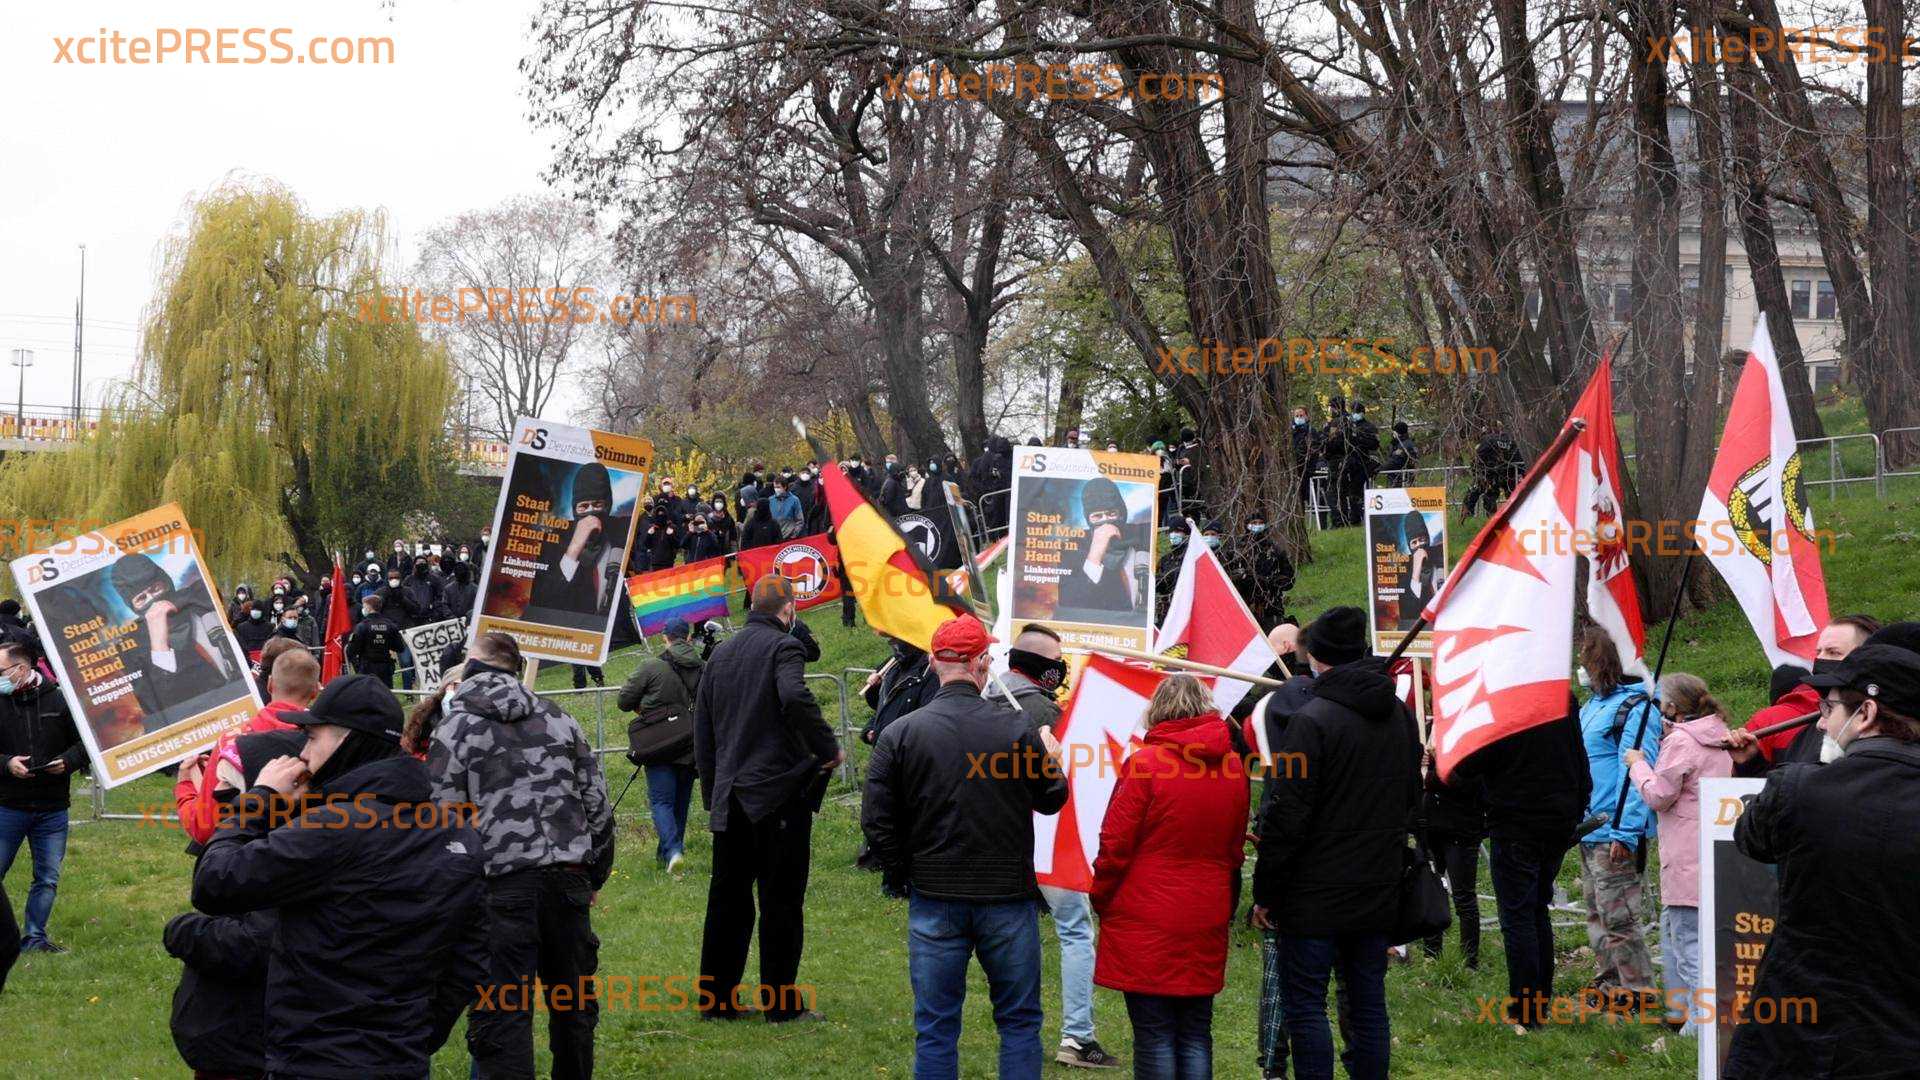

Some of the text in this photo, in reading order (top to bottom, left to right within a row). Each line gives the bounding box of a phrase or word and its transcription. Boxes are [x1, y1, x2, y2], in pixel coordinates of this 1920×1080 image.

[594, 445, 647, 467] Stimme
[1098, 462, 1154, 478] Stimme
[516, 494, 550, 511] Staat
[1411, 496, 1443, 508] Stimme
[513, 511, 570, 530] und Mob
[1026, 511, 1061, 524] Staat
[115, 519, 181, 550] Stimme
[509, 524, 560, 544] Hand in
[1026, 524, 1086, 538] und Mob
[506, 538, 542, 556] Hand
[1025, 537, 1078, 551] Hand in
[503, 556, 549, 571] Linksterror
[1024, 551, 1061, 563] Hand
[500, 566, 536, 579] stoppen!
[1024, 565, 1072, 576] Linksterror
[64, 616, 105, 639] Staat
[69, 621, 139, 653] und Mob
[75, 637, 139, 667] Hand in
[81, 657, 125, 682] Hand
[87, 669, 143, 696] Linksterror
[116, 711, 250, 770] DEUTSCHE-STIMME.DE
[1714, 796, 1744, 825] D
[1735, 912, 1775, 934] Sta
[1735, 943, 1764, 960] un
